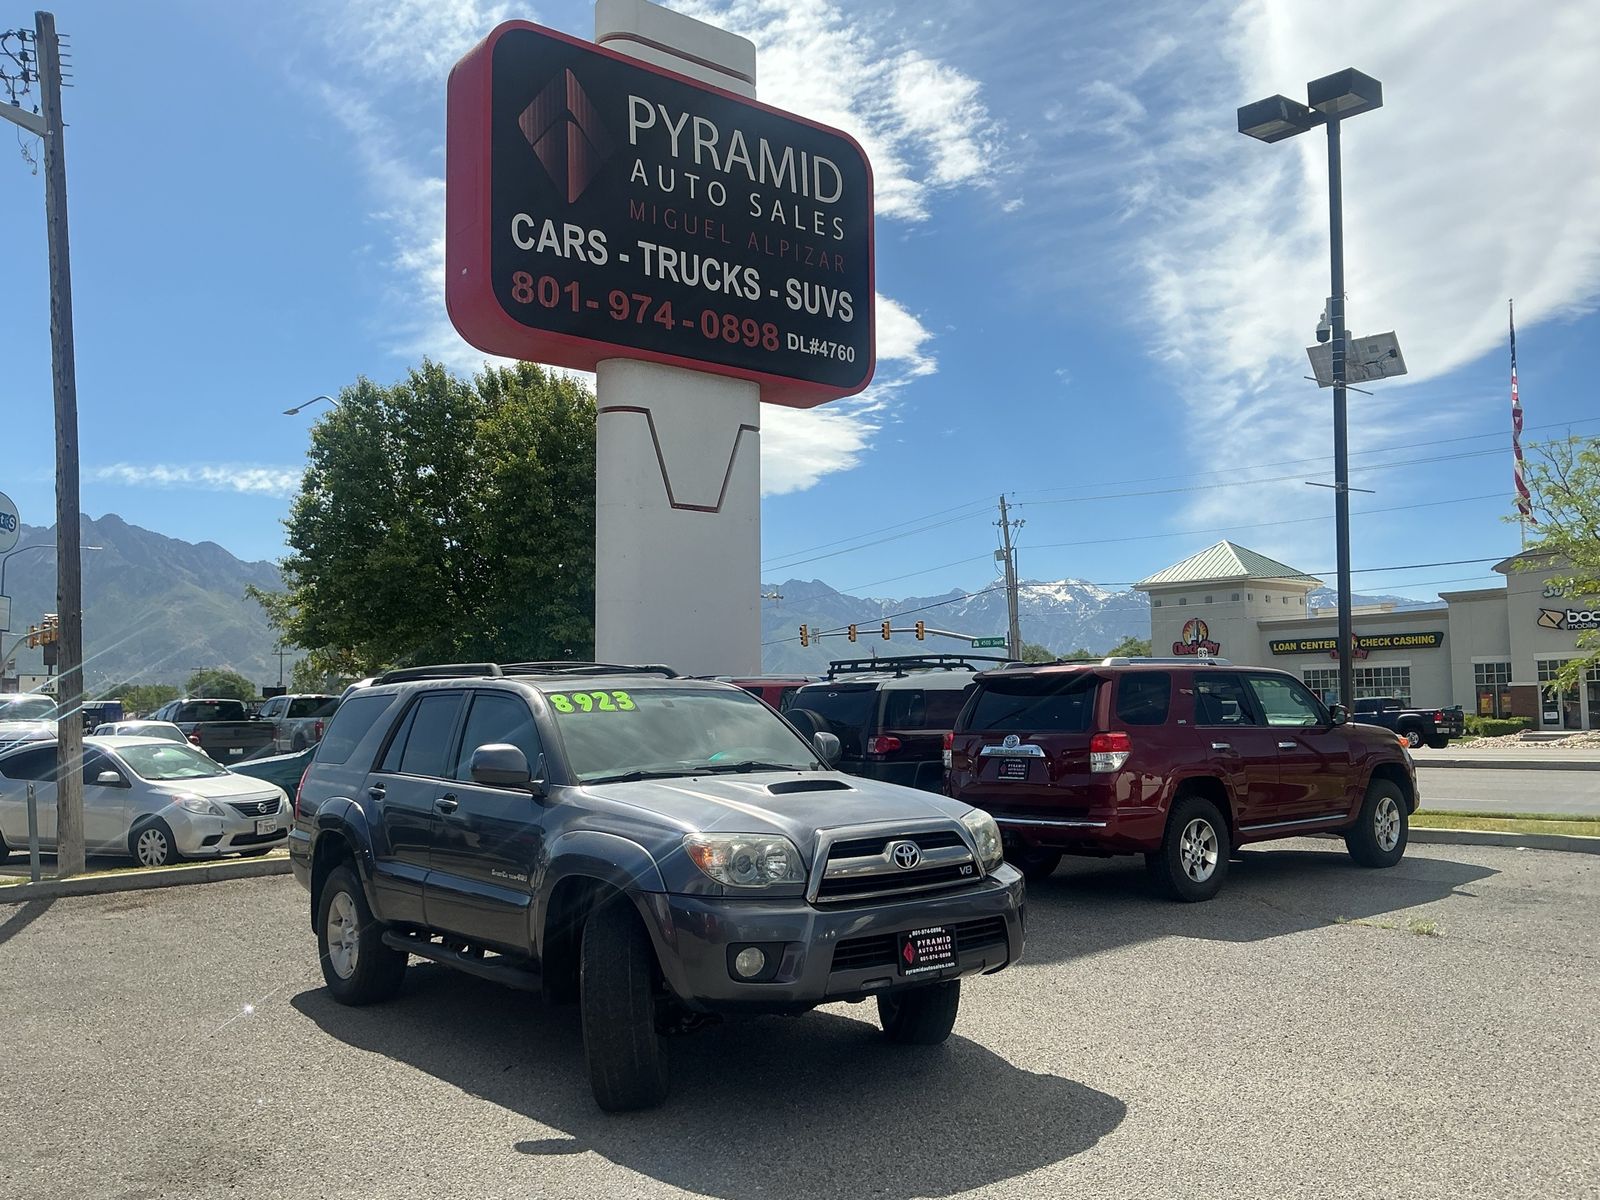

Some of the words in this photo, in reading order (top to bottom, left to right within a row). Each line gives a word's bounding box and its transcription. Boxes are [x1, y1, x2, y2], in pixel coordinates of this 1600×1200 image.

[628, 94, 844, 204] PYRAMID
[630, 158, 727, 207] AUTO
[749, 192, 845, 241] SALES
[630, 199, 731, 244] MIGUEL
[748, 231, 845, 273] ALPIZAR
[511, 213, 608, 266] CARS
[637, 240, 761, 301] TRUCKS
[785, 277, 854, 323] SUVS
[787, 332, 855, 363] DL#4760
[1567, 621, 1598, 630] mobile
[1273, 641, 1297, 651] LOAN
[1300, 640, 1337, 650] CENTER
[1360, 636, 1391, 647] CHECK
[1392, 635, 1435, 646] CASHING
[1199, 649, 1207, 658] 89
[549, 691, 636, 713] 8923
[916, 935, 952, 947] PYRAMID
[918, 946, 933, 954] AUTO
[934, 943, 952, 952] SALES
